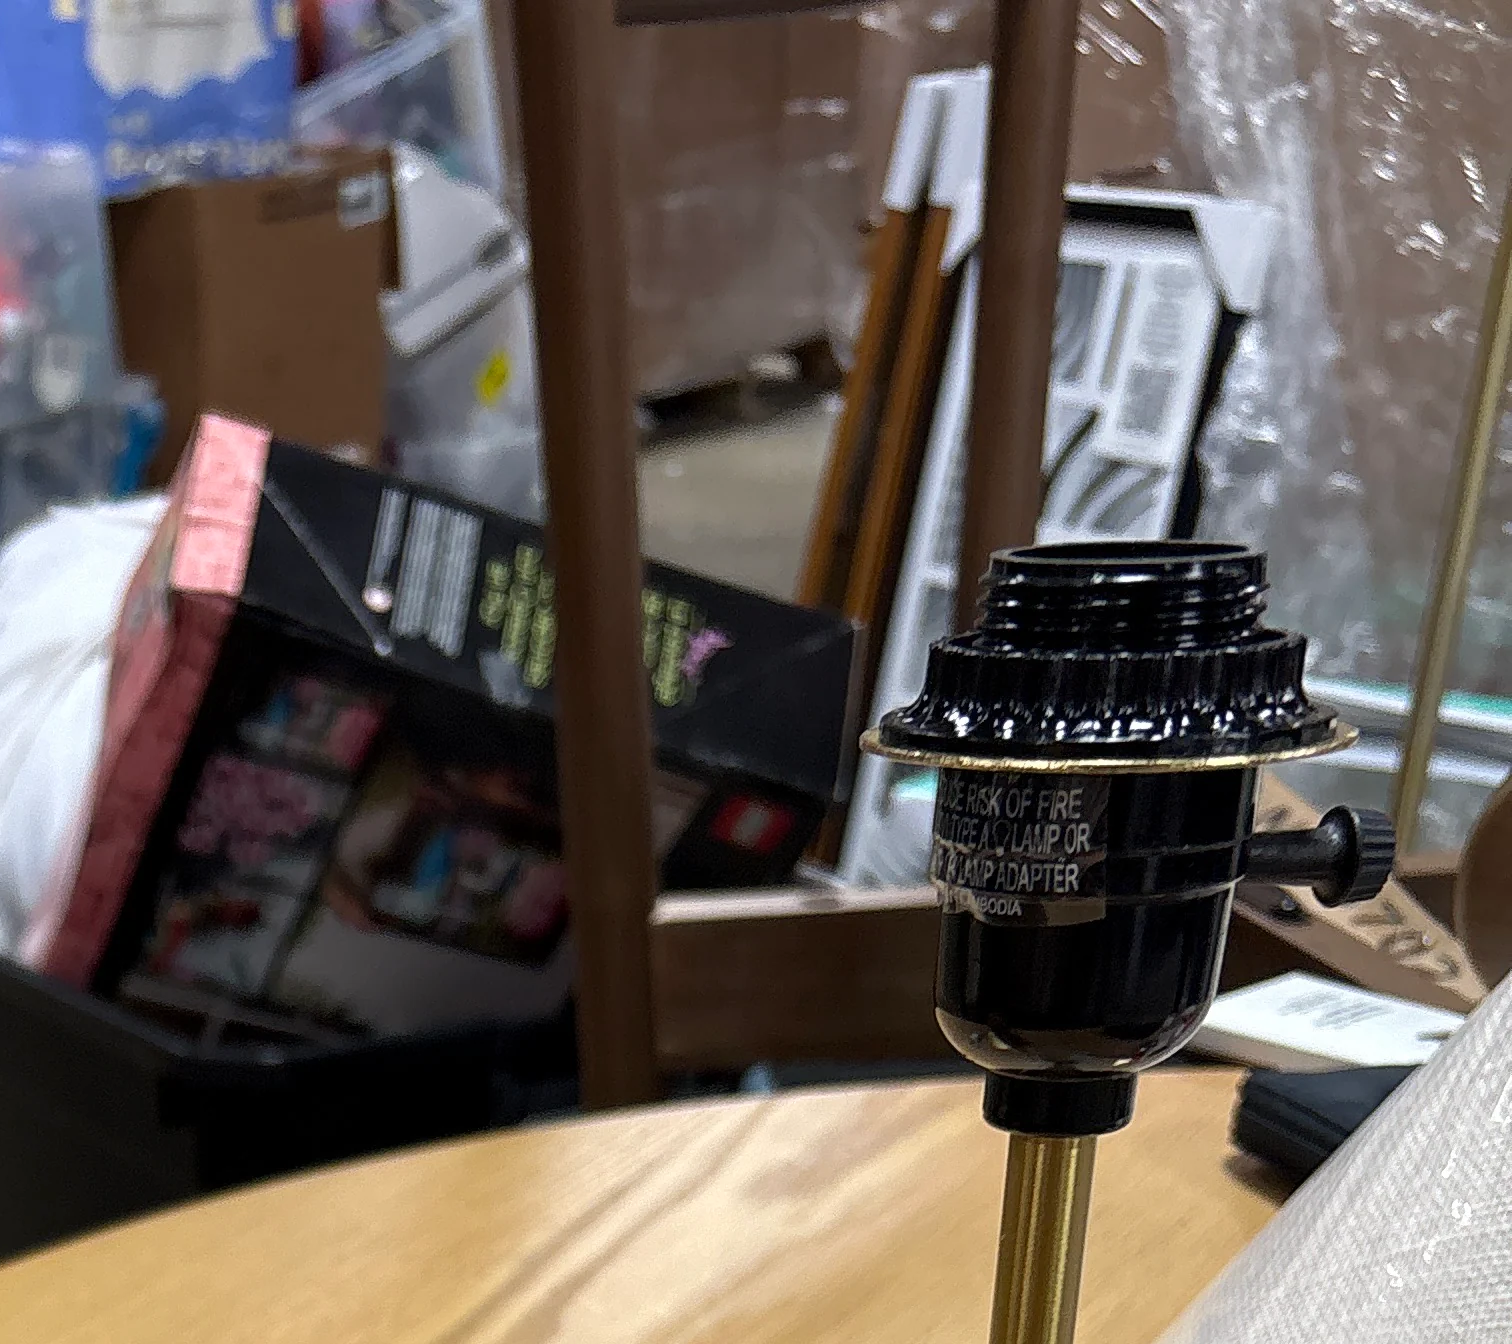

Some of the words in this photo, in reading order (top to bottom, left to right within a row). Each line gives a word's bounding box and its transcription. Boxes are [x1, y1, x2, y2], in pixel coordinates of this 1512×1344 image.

[966, 782, 1003, 817] RISK
[1005, 787, 1033, 819] OF
[1037, 786, 1084, 820] FIRE
[951, 814, 978, 848] TYPE
[1010, 823, 1060, 855] LAMP
[1063, 822, 1090, 855] OR
[994, 858, 1080, 894] ADAPTER
